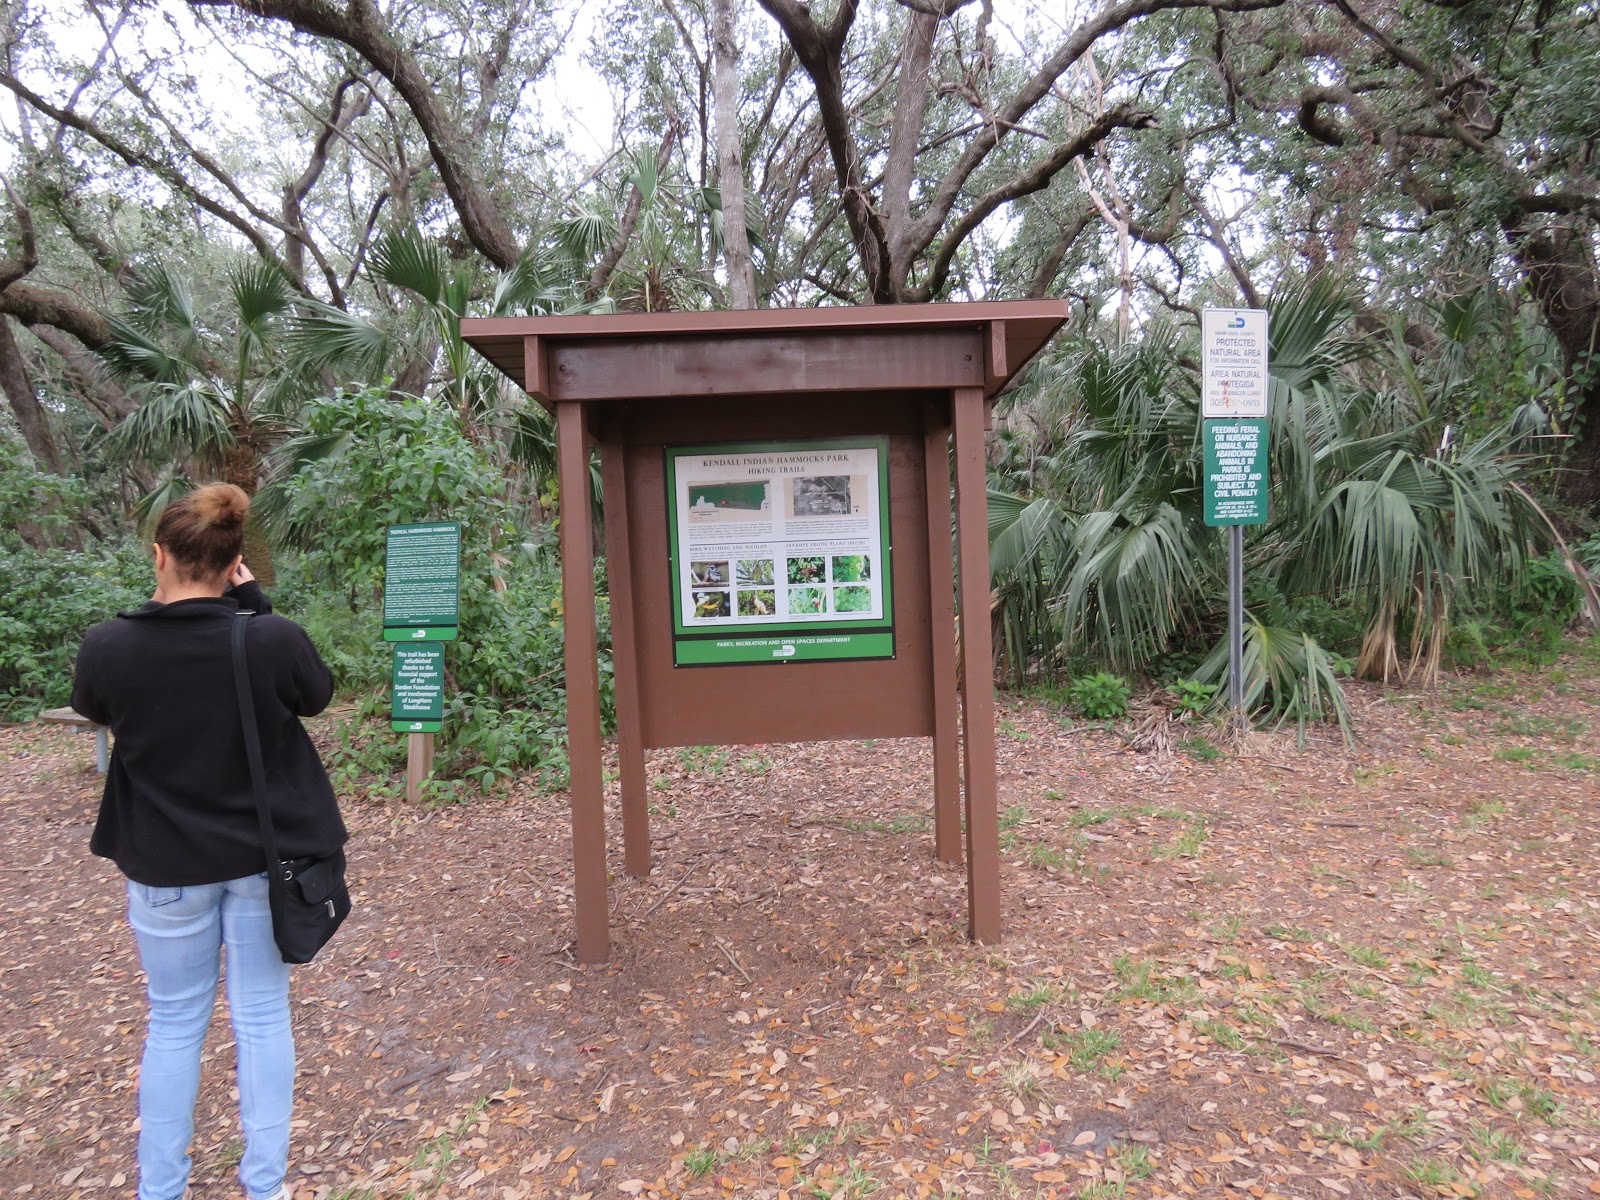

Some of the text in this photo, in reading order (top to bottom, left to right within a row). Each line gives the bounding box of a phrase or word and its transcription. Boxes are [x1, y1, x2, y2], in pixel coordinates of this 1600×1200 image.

[1216, 338, 1256, 346] PROTECTED
[1214, 442, 1242, 450] ANIMALS,
[777, 456, 824, 464] HAMMOCKS
[1217, 482, 1245, 490] SUBJECT
